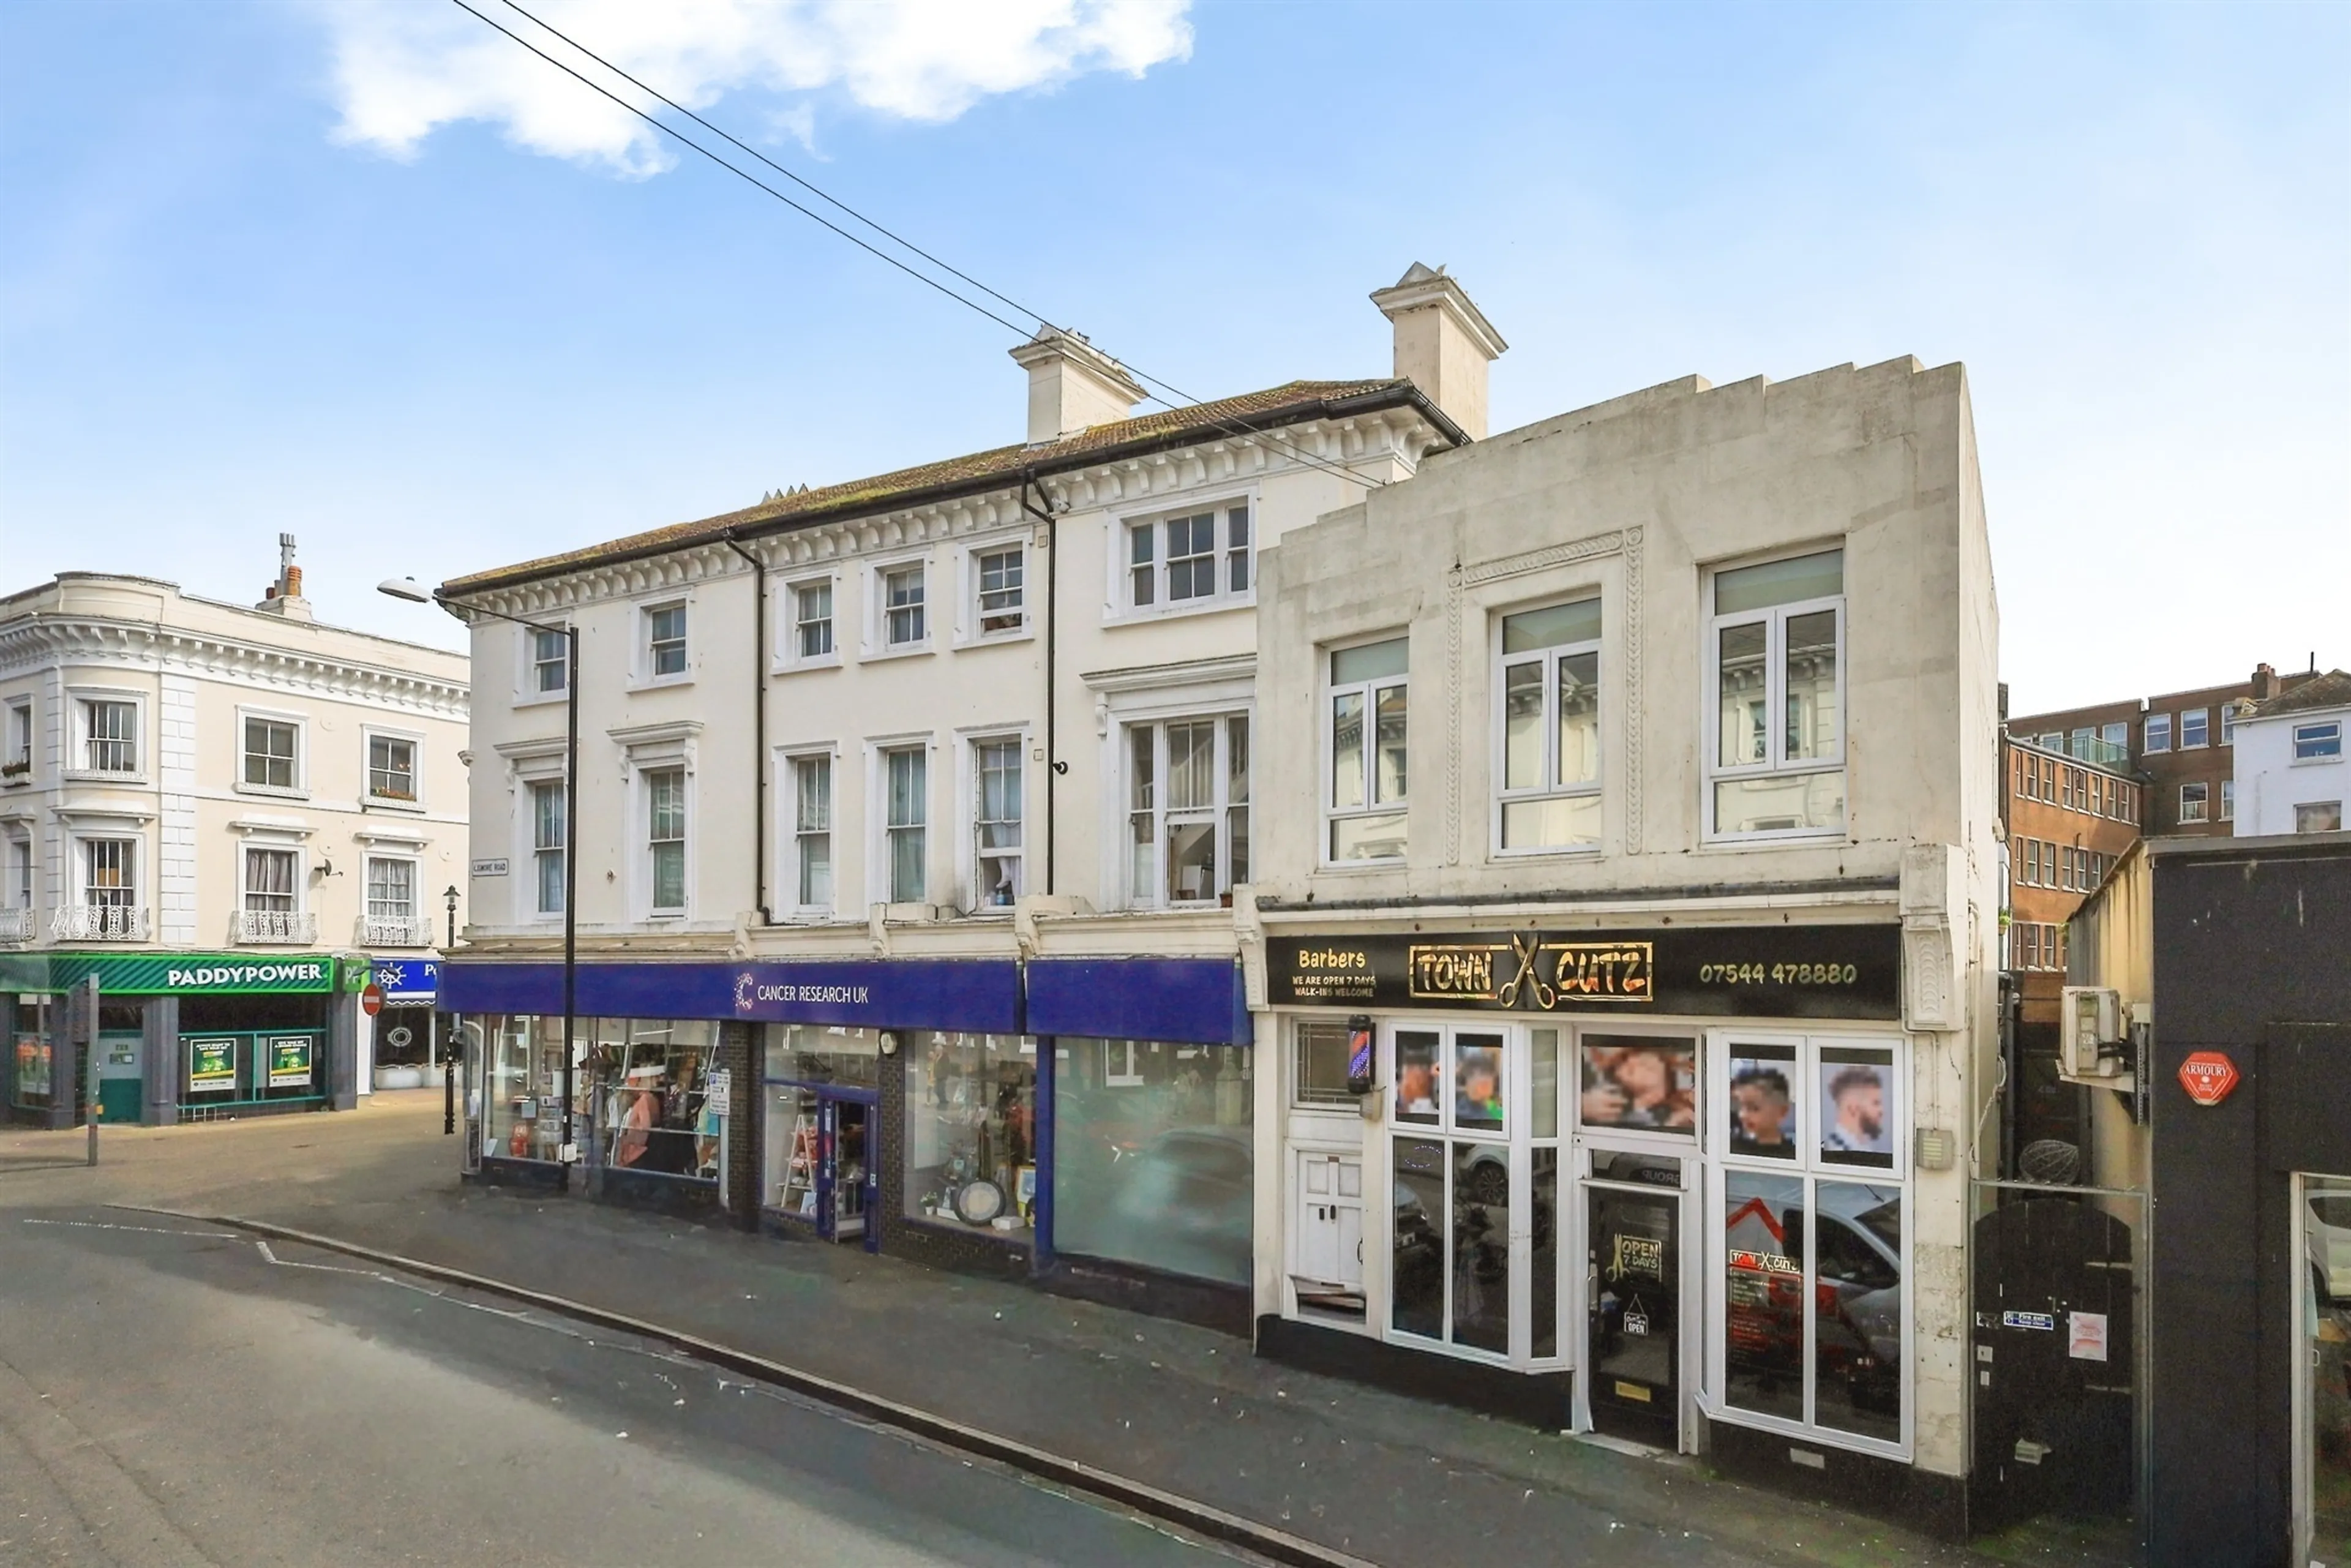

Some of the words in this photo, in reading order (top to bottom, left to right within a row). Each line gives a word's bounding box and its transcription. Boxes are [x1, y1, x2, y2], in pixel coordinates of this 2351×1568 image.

[1299, 948, 1366, 968] Barbers
[168, 964, 322, 986] PADDYPOWER
[1292, 976, 1303, 985] WE
[1305, 976, 1321, 985] ARE
[1322, 975, 1344, 985] OPEN
[1354, 976, 1376, 985] DAYS
[1417, 951, 1491, 991] TOWN
[1556, 951, 1646, 993] CUTZ
[1700, 963, 1765, 984] 07544
[1771, 963, 1857, 984] 478880
[757, 985, 796, 1001] CANCER
[799, 986, 850, 1003] RESEARCH
[853, 987, 868, 1003] UK
[1295, 987, 1333, 996] WALK-INS
[1335, 988, 1373, 997] WELCOME
[2184, 1065, 2226, 1076] ARMOURY
[1622, 1240, 1658, 1258] OPEN
[1623, 1255, 1630, 1264] 7
[1632, 1256, 1658, 1269] DAYS
[1628, 1323, 1644, 1334] OPEN
